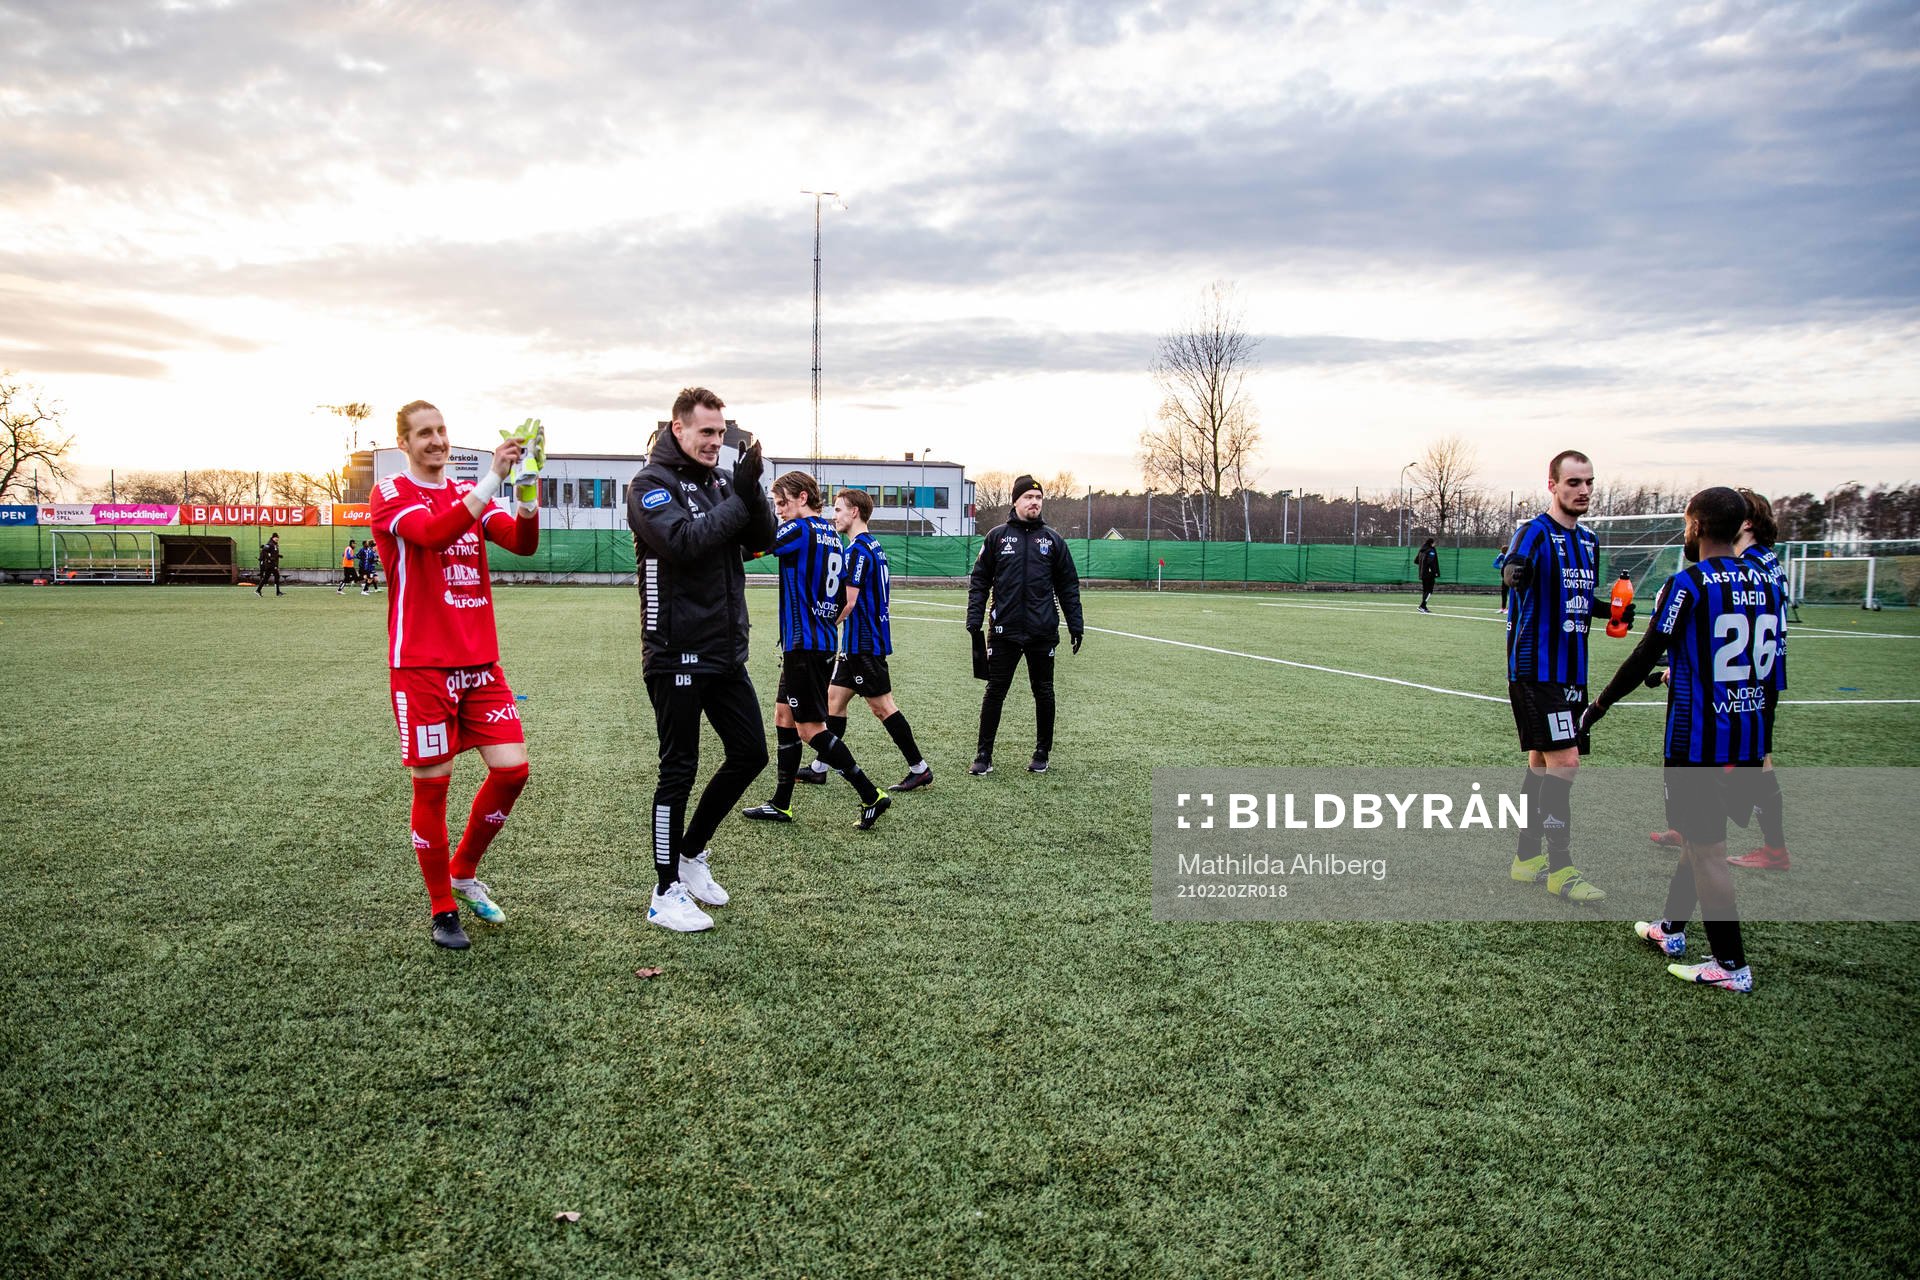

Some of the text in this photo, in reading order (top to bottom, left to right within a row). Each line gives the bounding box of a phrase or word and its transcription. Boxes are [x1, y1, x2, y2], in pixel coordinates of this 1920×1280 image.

[0, 511, 26, 520] PEN
[100, 511, 119, 520] Heja
[194, 507, 304, 521] BAUHAUS
[825, 552, 842, 598] 8
[1732, 590, 1766, 606] SAEID
[1663, 589, 1687, 635] stadium
[1714, 613, 1778, 682] 26
[675, 674, 692, 686] DB
